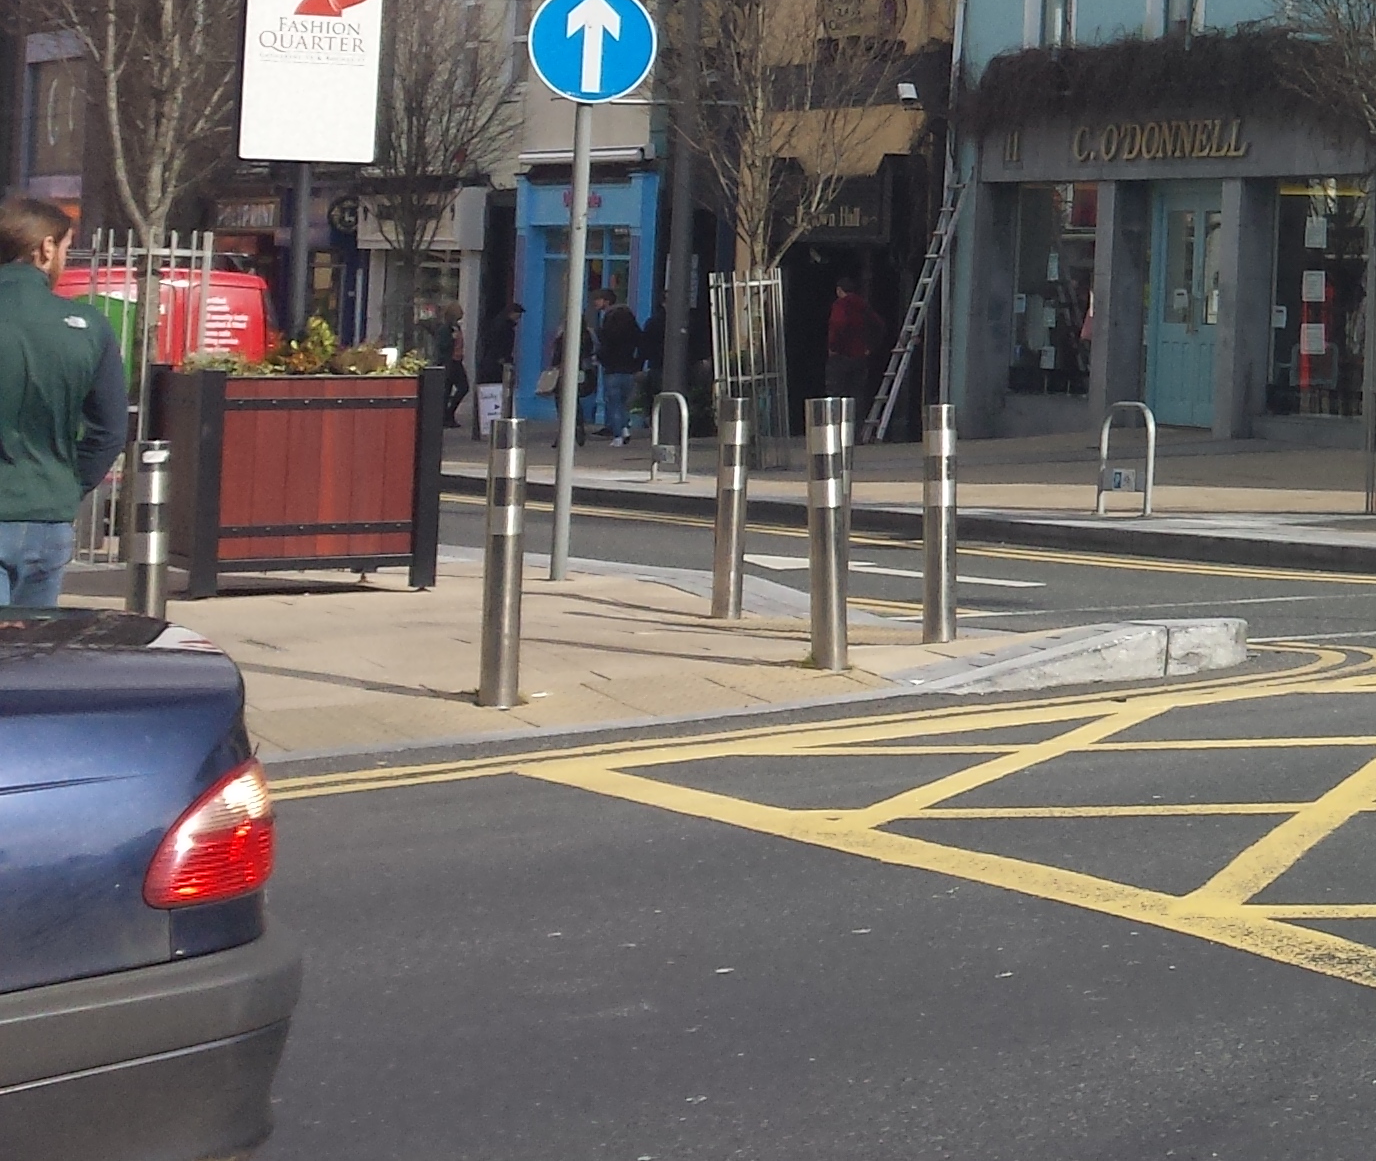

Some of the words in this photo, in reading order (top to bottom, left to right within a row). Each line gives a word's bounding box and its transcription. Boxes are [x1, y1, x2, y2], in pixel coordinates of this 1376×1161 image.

[279, 17, 361, 35] FASHION
[259, 30, 365, 53] QUARTER
[1072, 126, 1096, 161] C.
[1102, 119, 1247, 161] O'DONNELL
